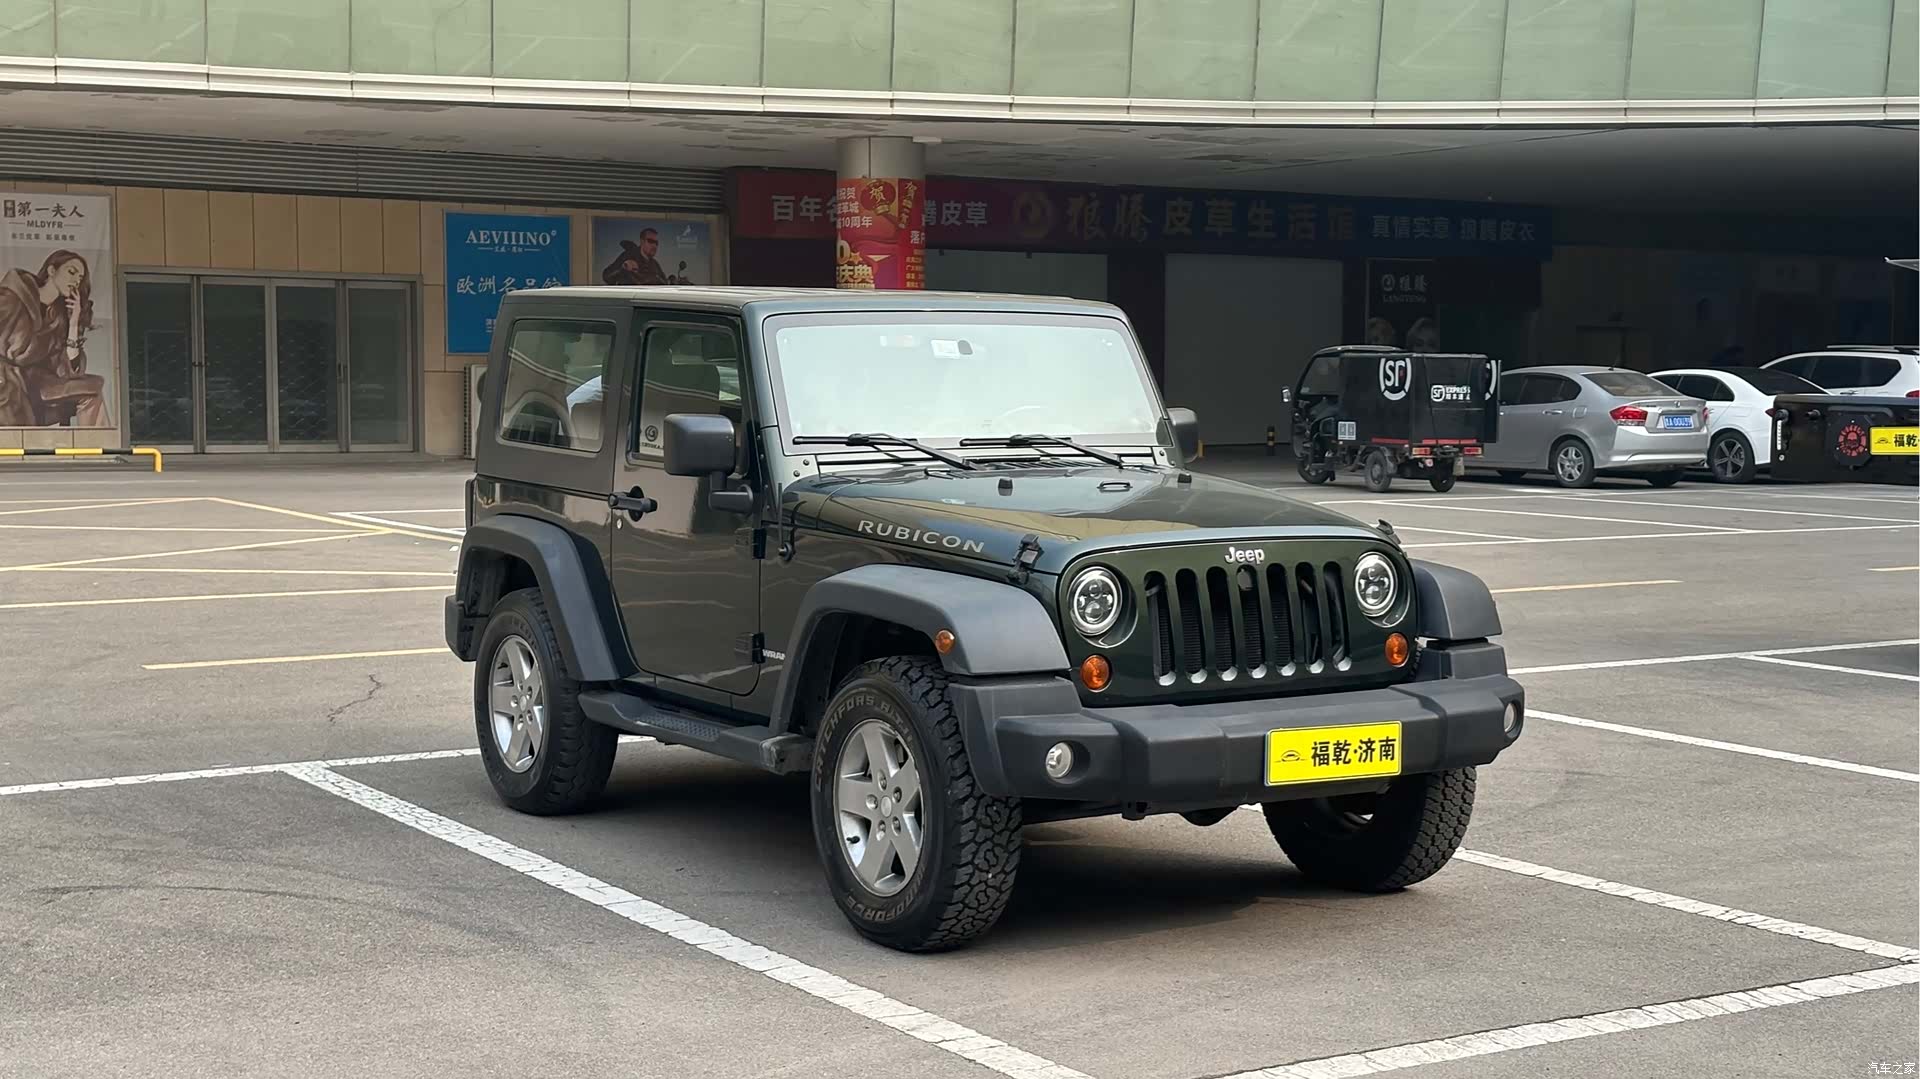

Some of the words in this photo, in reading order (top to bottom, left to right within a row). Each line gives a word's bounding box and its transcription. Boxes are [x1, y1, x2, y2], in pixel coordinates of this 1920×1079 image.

[17, 201, 85, 218] 第一夫人
[858, 520, 985, 552] RUBICON
[1225, 546, 1265, 564] Jeep
[1311, 736, 1397, 767] 福乾·济南
